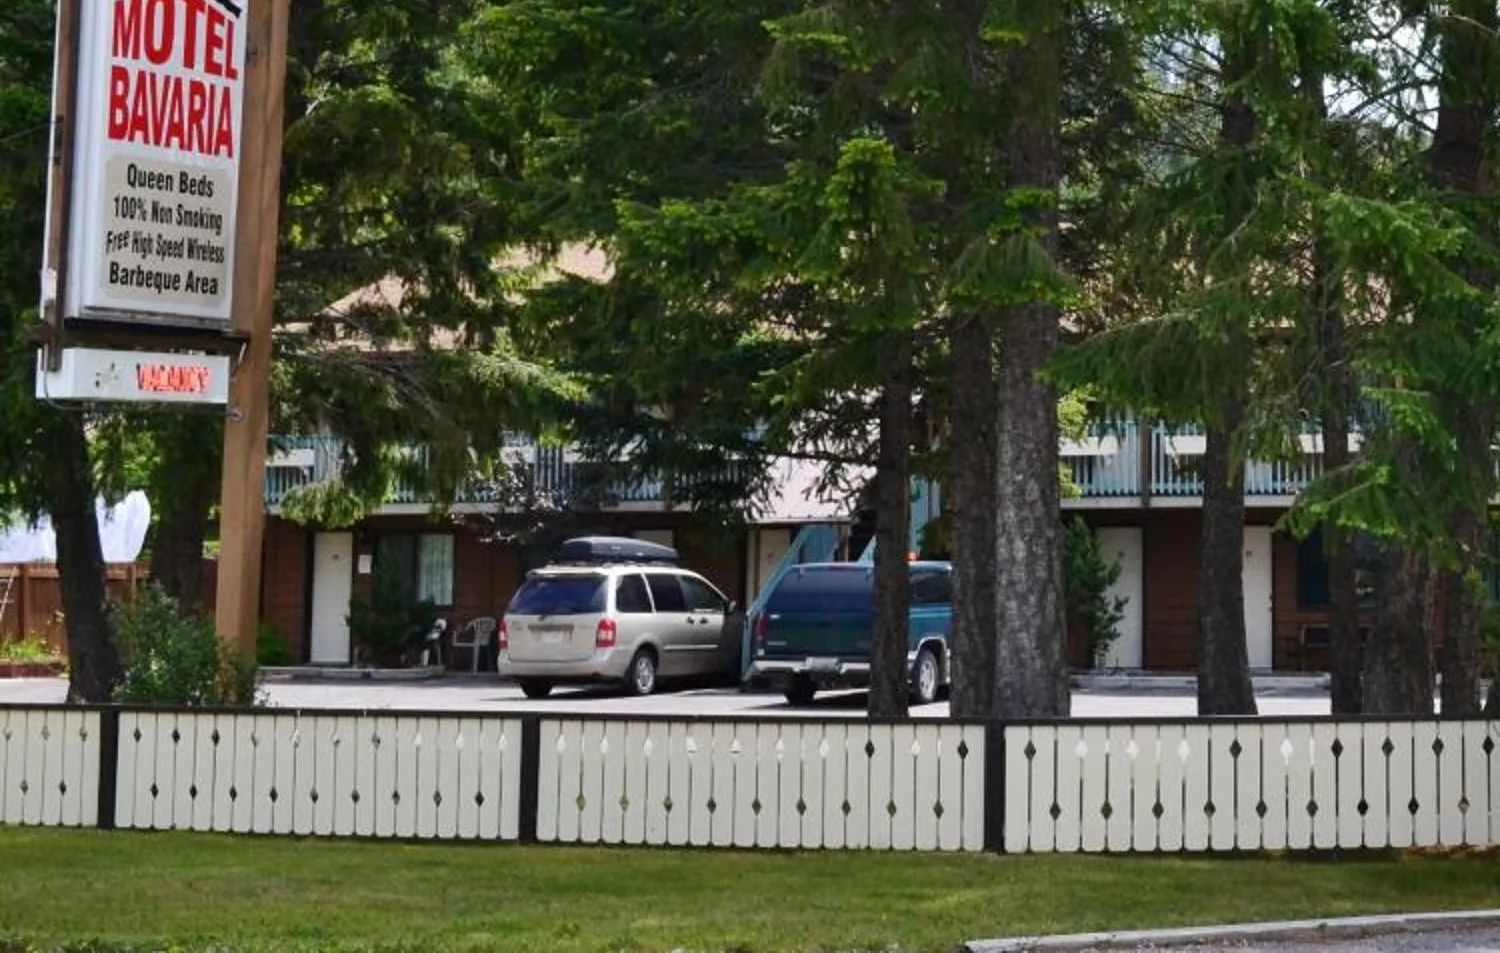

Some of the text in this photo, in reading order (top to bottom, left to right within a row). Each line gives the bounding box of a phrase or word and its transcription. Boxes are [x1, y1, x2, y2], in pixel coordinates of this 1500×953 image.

[108, 65, 233, 159] BAVARIA
[127, 163, 214, 198] Queen Beds
[114, 194, 223, 236] 100% Non Smoking
[106, 230, 225, 264] Free High Speed Wireless
[109, 261, 219, 295] Barbeque Area
